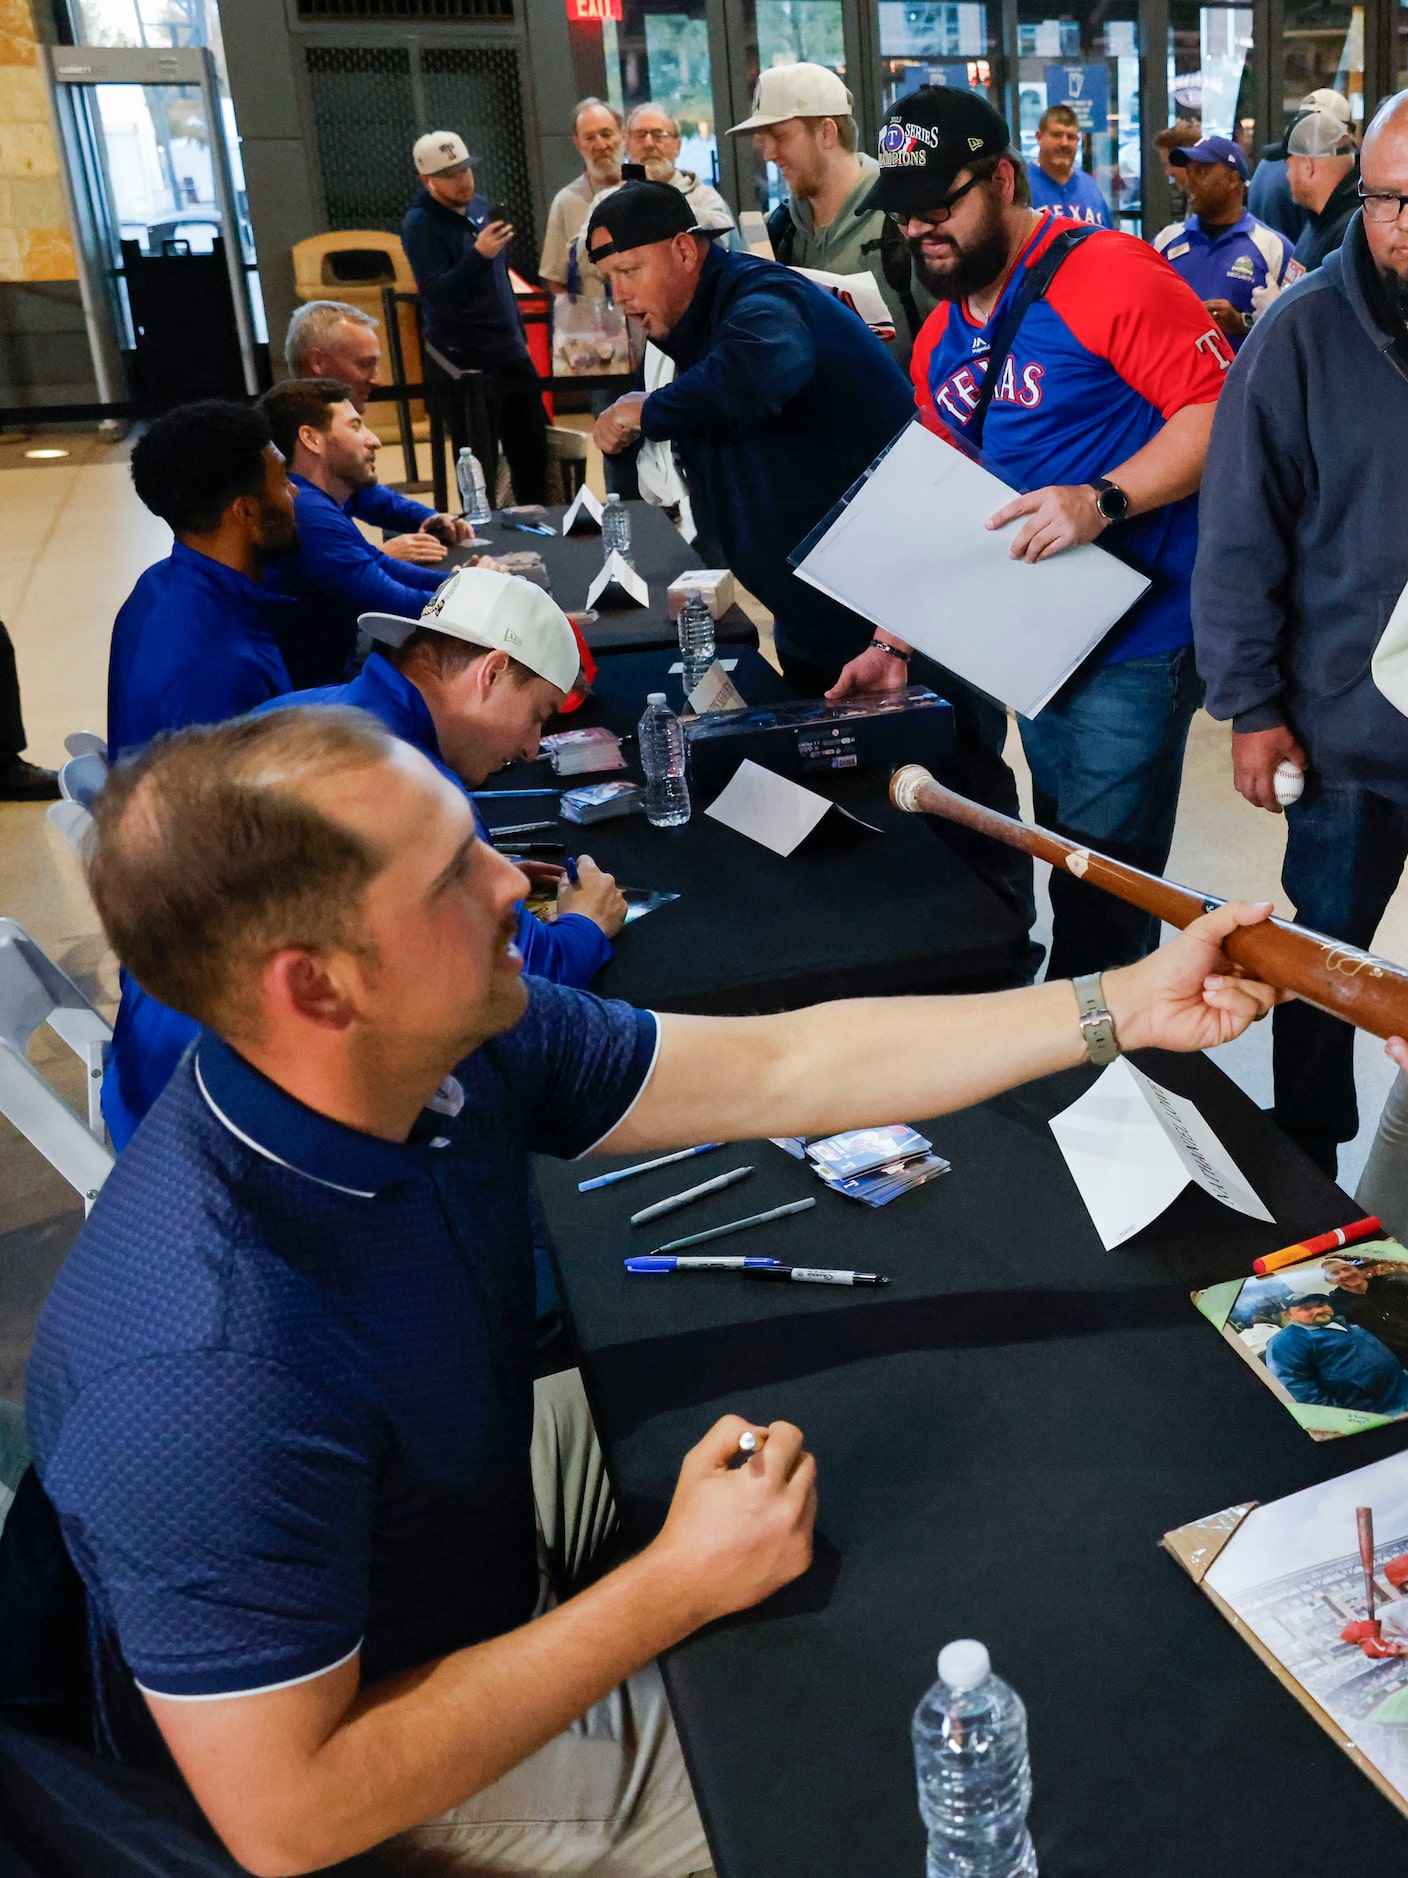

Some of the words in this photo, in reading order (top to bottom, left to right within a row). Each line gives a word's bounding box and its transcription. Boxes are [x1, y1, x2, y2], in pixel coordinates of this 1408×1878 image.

[887, 130, 898, 146] T
[905, 122, 939, 149] SERIES
[879, 149, 927, 168] AMPIONS
[1195, 329, 1231, 370] T
[1171, 1122, 1234, 1206] NATHANIEL
